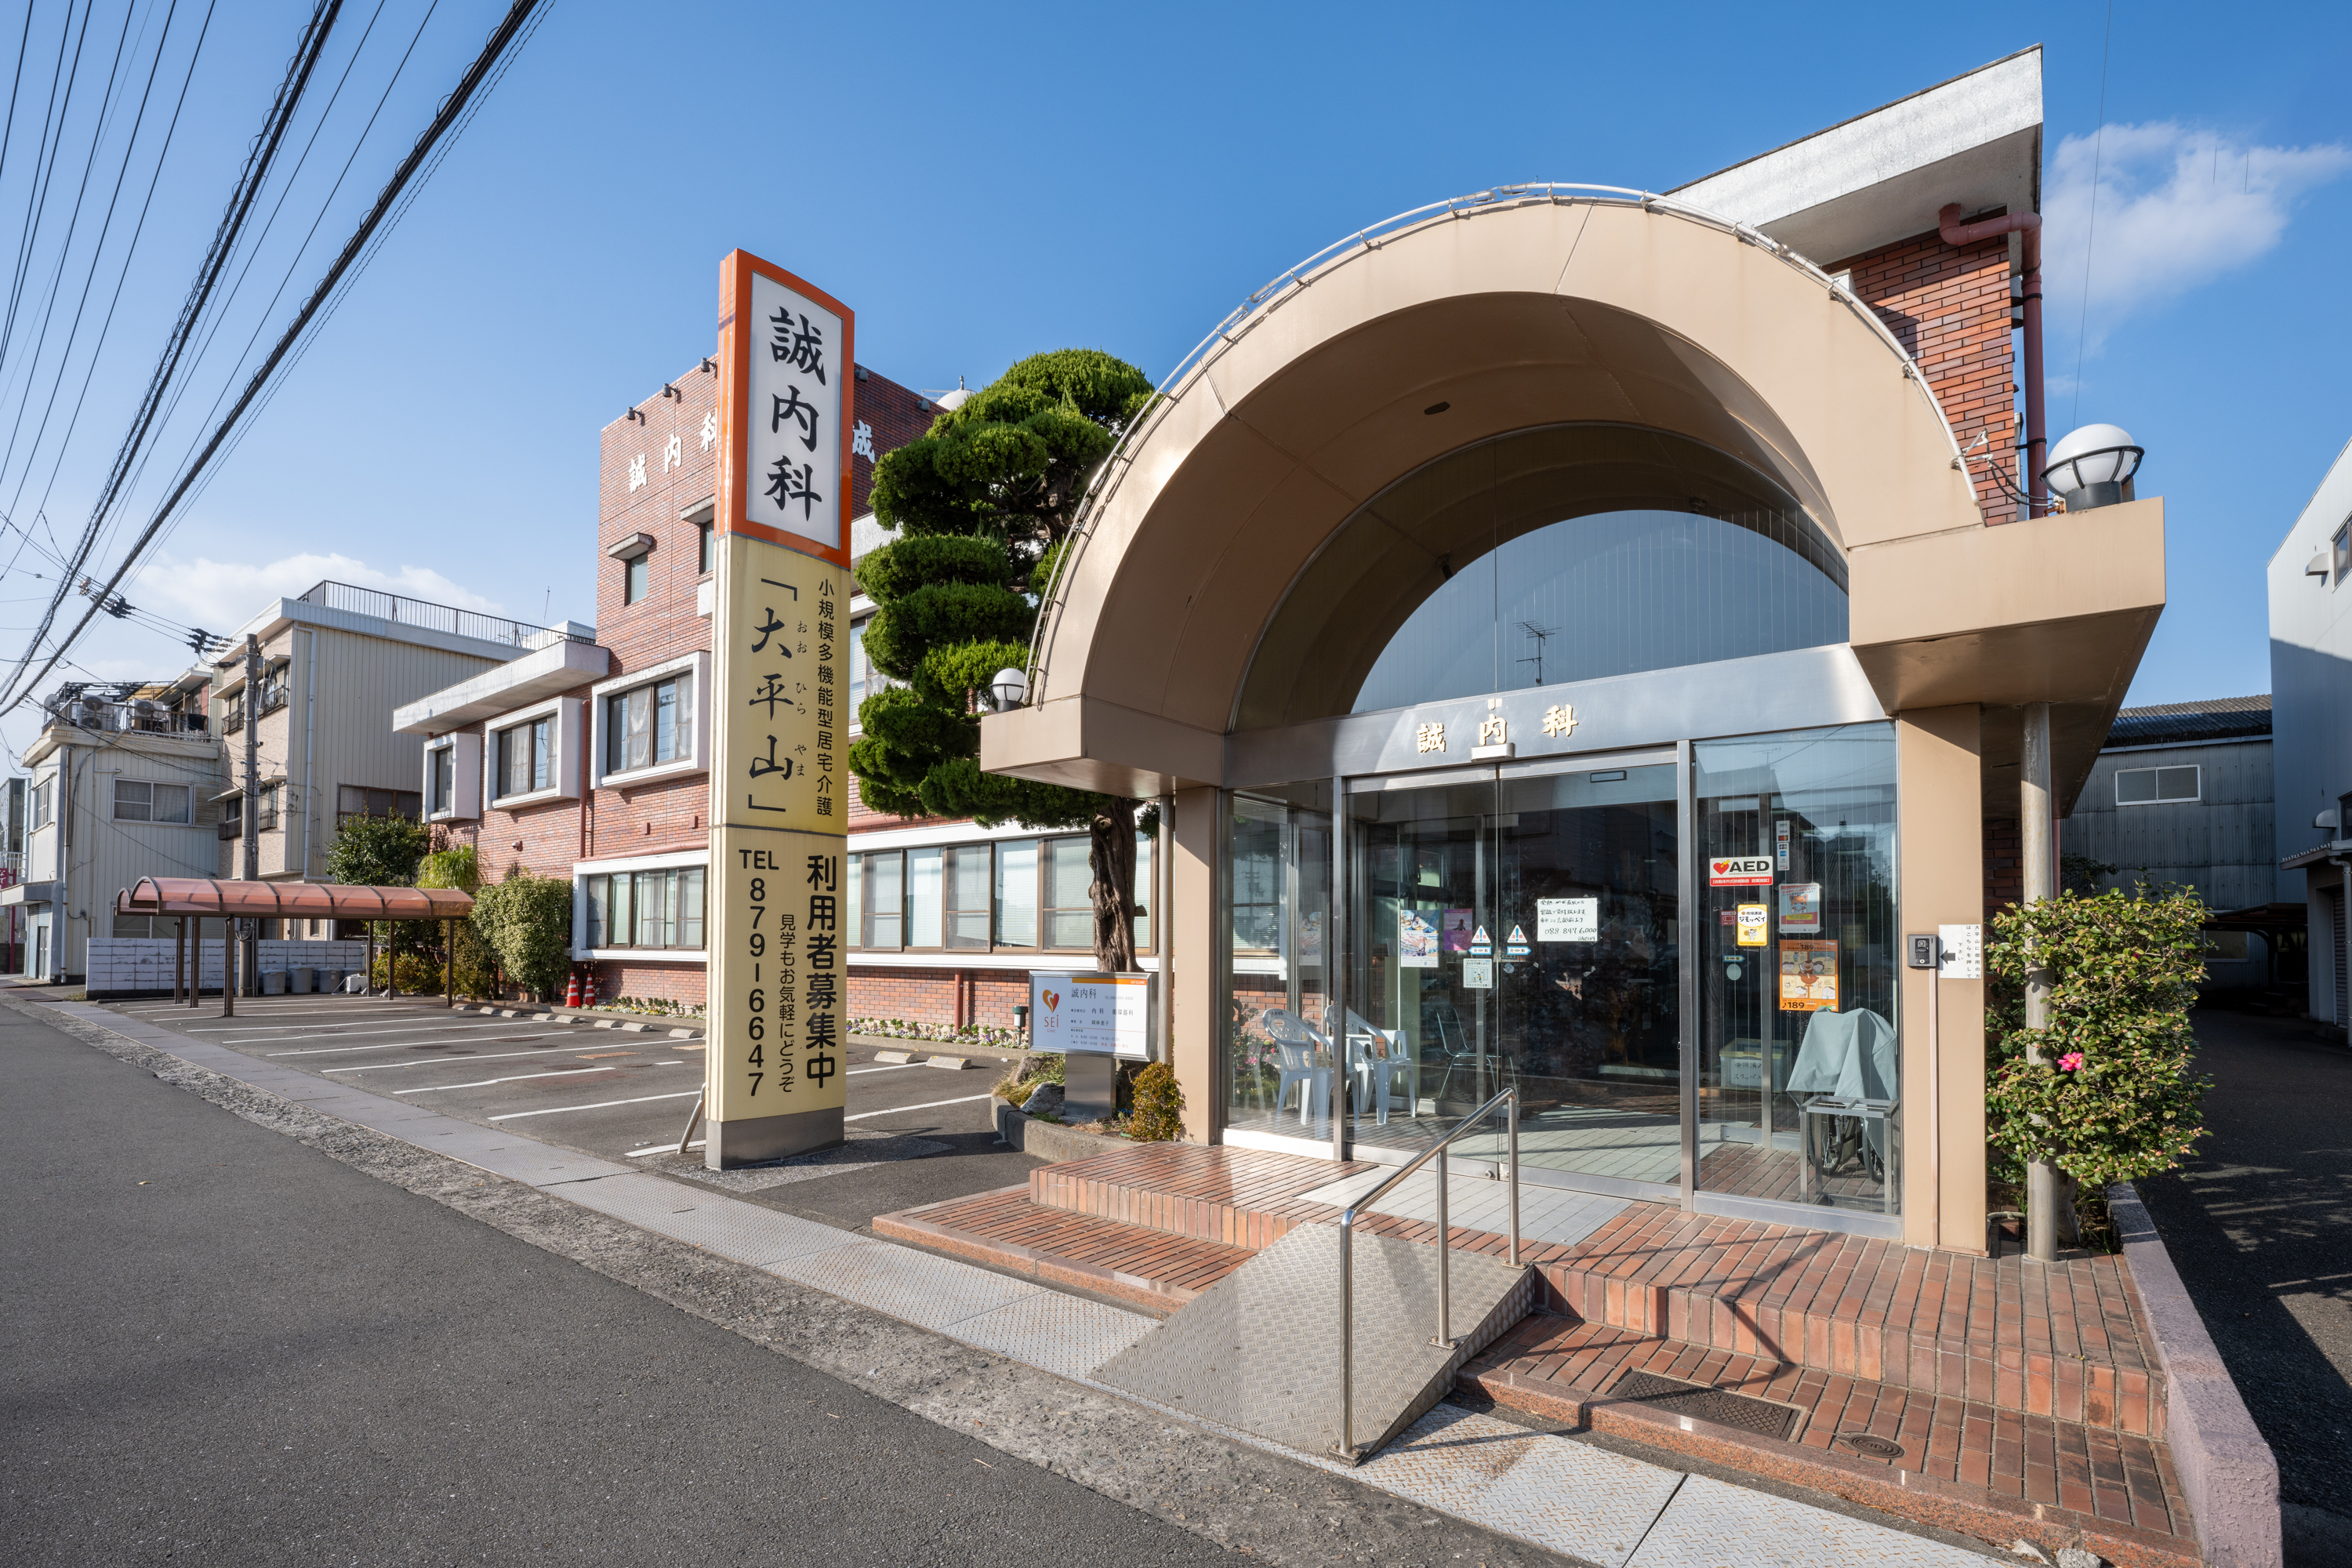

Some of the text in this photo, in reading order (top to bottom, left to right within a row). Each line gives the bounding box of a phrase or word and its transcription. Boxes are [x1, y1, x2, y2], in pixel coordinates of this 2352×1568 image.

[764, 306, 826, 521] 誠内科
[748, 578, 797, 812] 「大平山」
[817, 579, 834, 817] 小規模多機能型居宅介護
[1416, 704, 1578, 753] 誠内科
[739, 849, 779, 870] TEL
[1729, 860, 1770, 873] AED
[779, 914, 796, 1093] 見学もお気軽にどうぞ
[806, 855, 837, 1089] 利用者募集中
[1071, 988, 1097, 999] 誠内科
